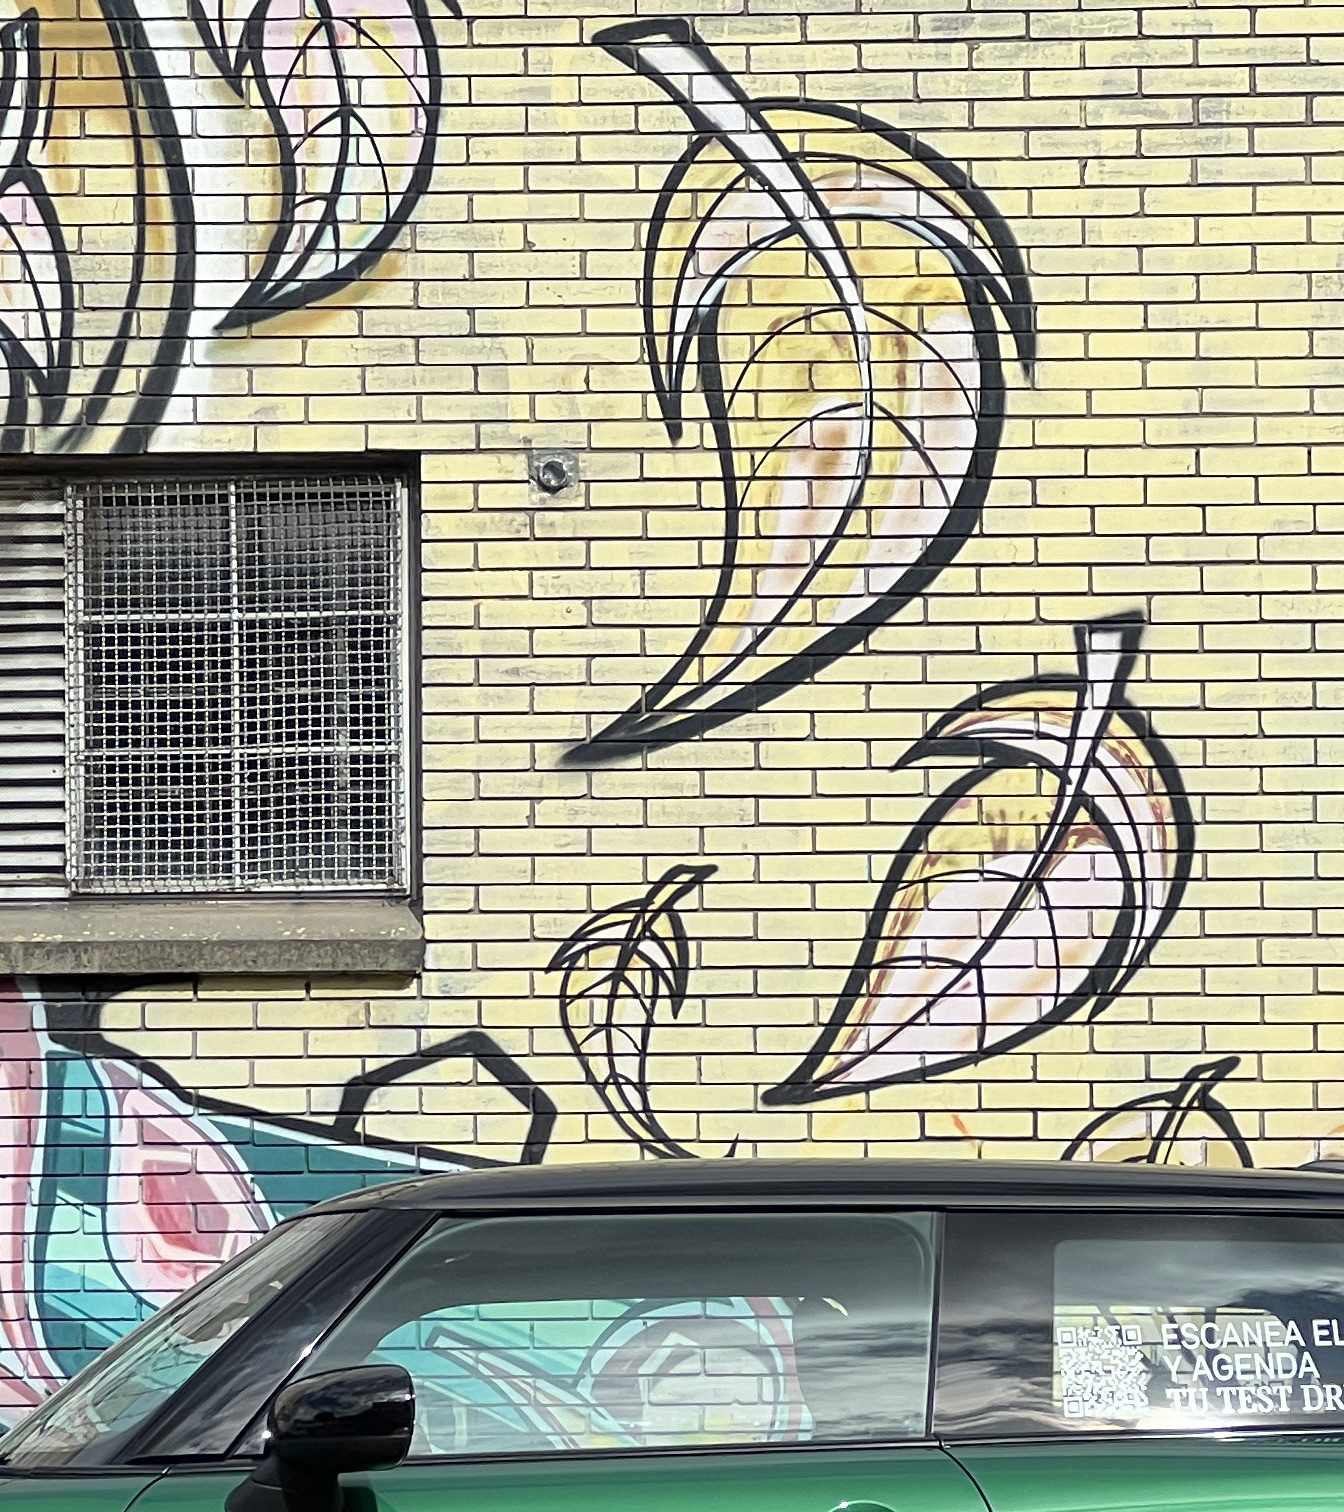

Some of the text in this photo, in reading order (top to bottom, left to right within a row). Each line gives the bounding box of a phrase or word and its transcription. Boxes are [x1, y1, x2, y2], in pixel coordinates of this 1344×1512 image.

[1161, 1320, 1306, 1350] ESCANEA
[1163, 1351, 1321, 1382] Y AGENDA
[1165, 1387, 1208, 1413] TU
[1216, 1385, 1293, 1414] TEST
